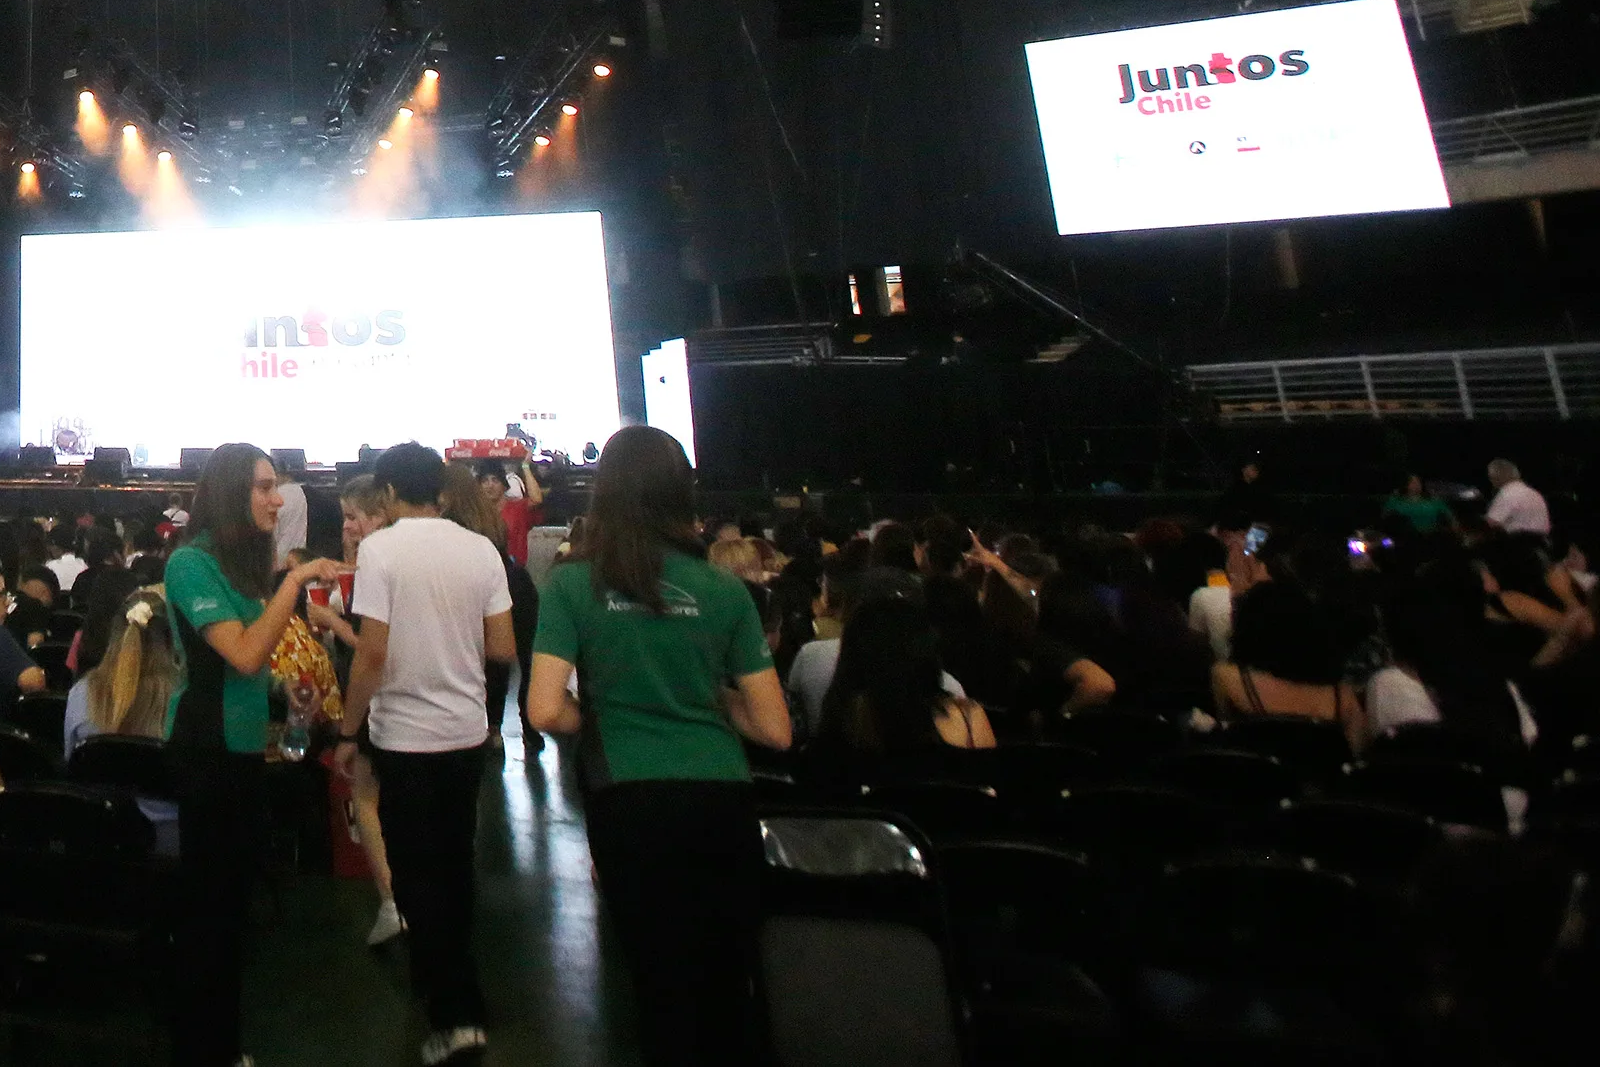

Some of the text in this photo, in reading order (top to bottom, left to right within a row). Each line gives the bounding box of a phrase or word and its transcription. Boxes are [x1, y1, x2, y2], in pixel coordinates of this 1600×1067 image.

[1117, 49, 1310, 104] Juntos
[1136, 91, 1212, 116] Chile
[240, 351, 299, 379] hile
